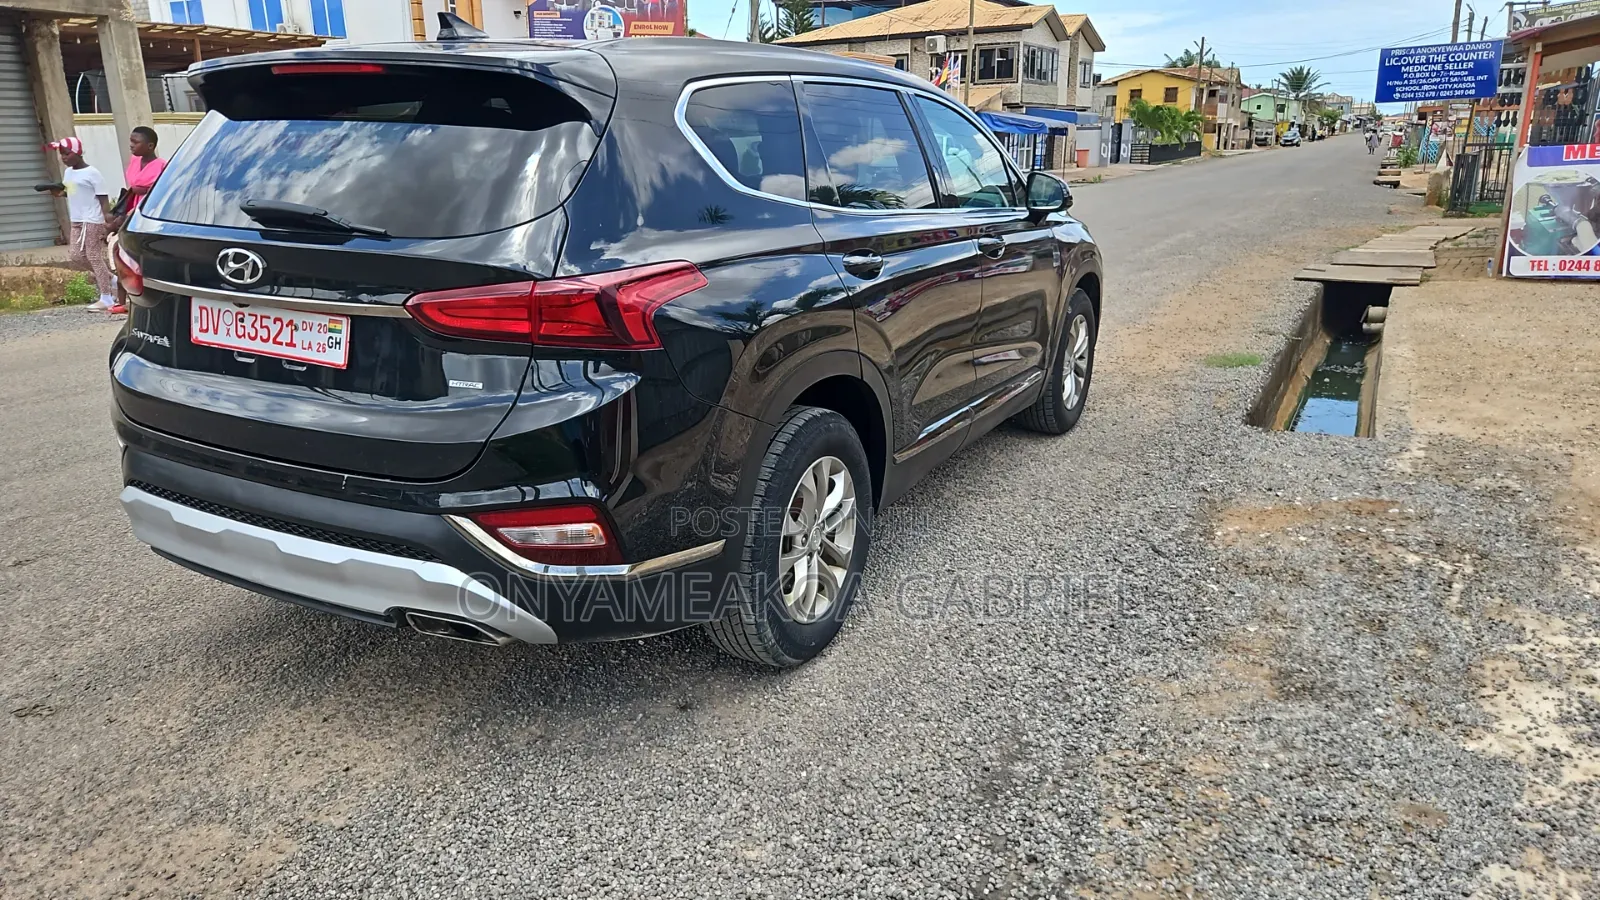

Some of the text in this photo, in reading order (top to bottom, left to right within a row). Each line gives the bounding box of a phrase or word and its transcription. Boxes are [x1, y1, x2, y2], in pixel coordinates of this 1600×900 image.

[1391, 42, 1492, 56] PRISCA ANOKYEWAA DANSO
[1428, 53, 1447, 63] THE
[1448, 51, 1495, 62] COUNTER
[1401, 61, 1474, 73] MEDICINE SELLER
[1529, 259, 1550, 272] TEL
[1558, 259, 1591, 272] 0244
[301, 320, 328, 334] DV 20
[301, 339, 327, 354] LA 26
[327, 335, 342, 351] GH
